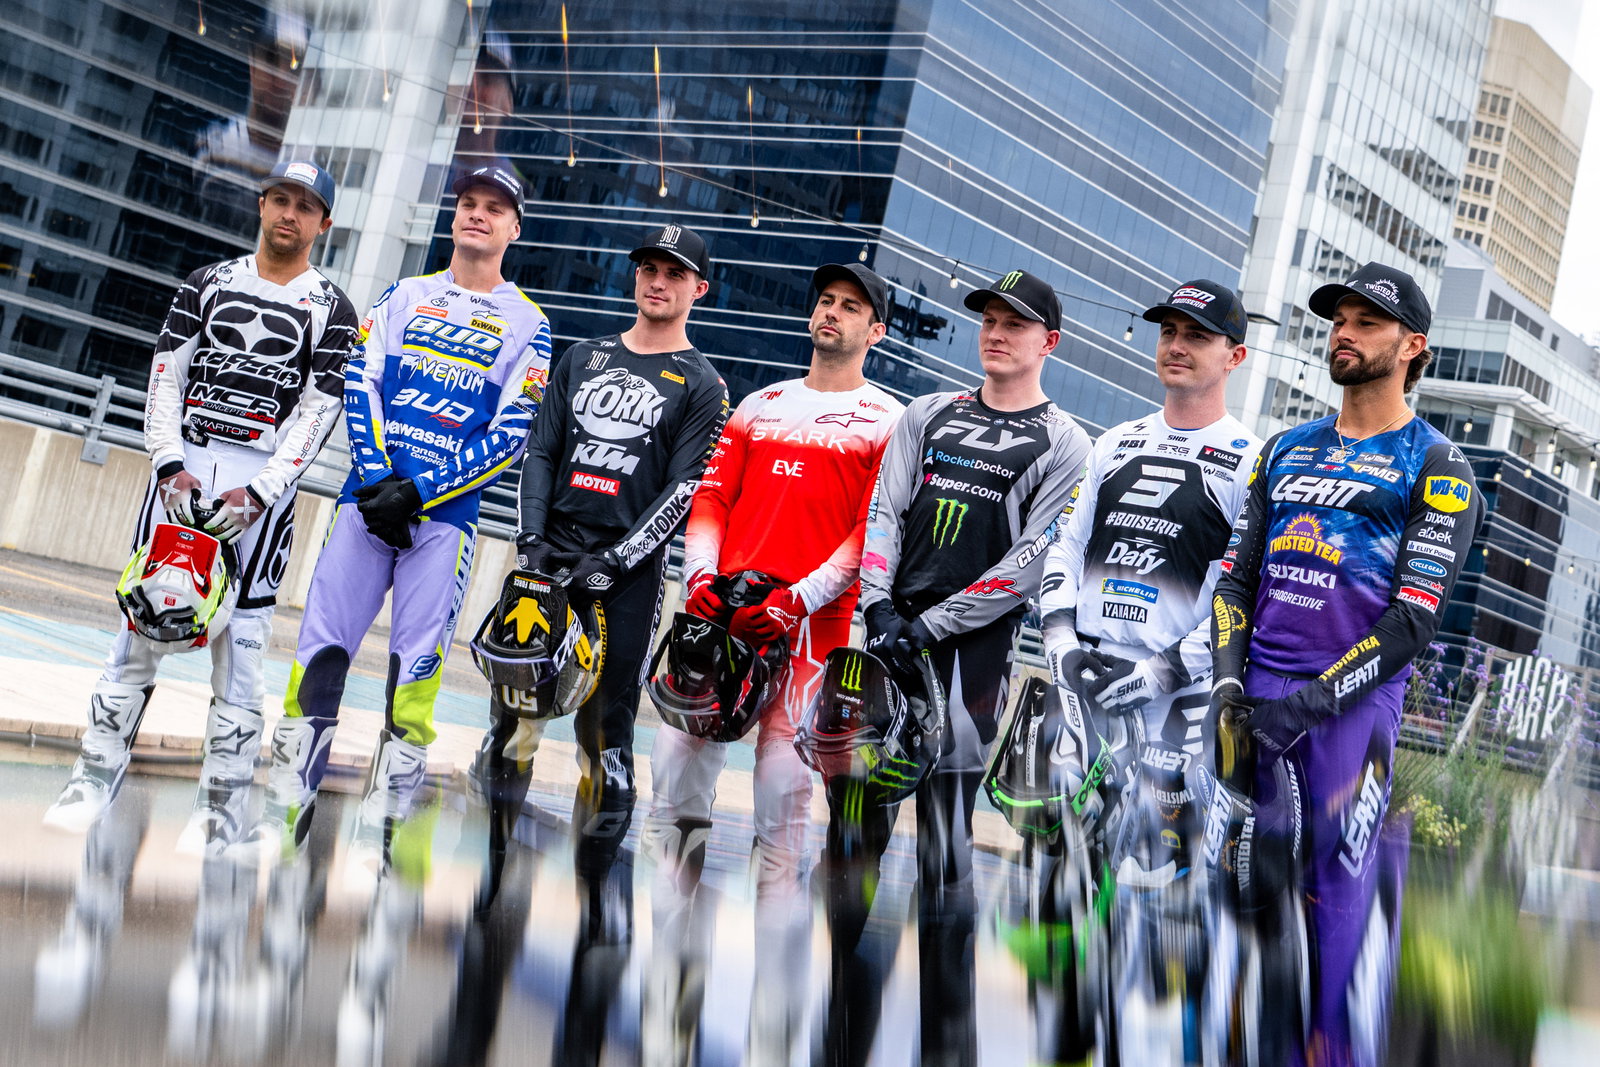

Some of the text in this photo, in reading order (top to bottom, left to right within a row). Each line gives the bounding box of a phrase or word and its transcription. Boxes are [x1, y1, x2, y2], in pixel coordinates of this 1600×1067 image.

[1364, 283, 1390, 299] TWISTED
[1388, 291, 1400, 305] TEA
[405, 315, 503, 352] BUD
[420, 355, 486, 395] VENUM
[602, 367, 646, 390] Pro
[188, 382, 281, 418] MCR
[390, 388, 475, 423] BUD
[573, 380, 668, 429] TORK
[759, 389, 784, 401] FIM
[190, 416, 250, 437] SMARTOP
[385, 419, 464, 454] Kawasaki
[752, 426, 849, 455] STARK
[930, 419, 1037, 453] FLY
[1166, 434, 1189, 443] SHOT
[570, 439, 641, 476] KTM
[771, 459, 805, 478] EVE
[935, 450, 1016, 480] RocketDoctor
[1212, 450, 1239, 465] YUASA
[572, 474, 617, 494] MOTUL
[929, 473, 1003, 503] Super.com
[1357, 465, 1401, 484] PMG
[1270, 475, 1377, 508] LEATT
[1430, 478, 1469, 504] WD-40
[643, 493, 692, 543] TORK
[1104, 511, 1183, 538] #BOISERIE
[1425, 511, 1456, 528] DIXXON
[1104, 542, 1167, 576] Dafy
[1269, 534, 1343, 567] TWISTED TEA
[1434, 549, 1454, 561] Power
[1267, 563, 1336, 590] SUZUKI
[1411, 561, 1444, 575] CYCLE GEAR
[1117, 585, 1157, 600] MICHELIN
[1267, 588, 1326, 611] PROGRESSIVE
[1104, 603, 1147, 622] YAMAHA
[869, 633, 887, 649] FLY
[1318, 635, 1382, 685] TWISTED TEA
[1335, 654, 1381, 699] LEATT
[1502, 655, 1569, 698] HIGH
[1140, 745, 1192, 775] LEATT
[1247, 816, 1256, 840] TEA
[1338, 761, 1383, 879] LEATT
